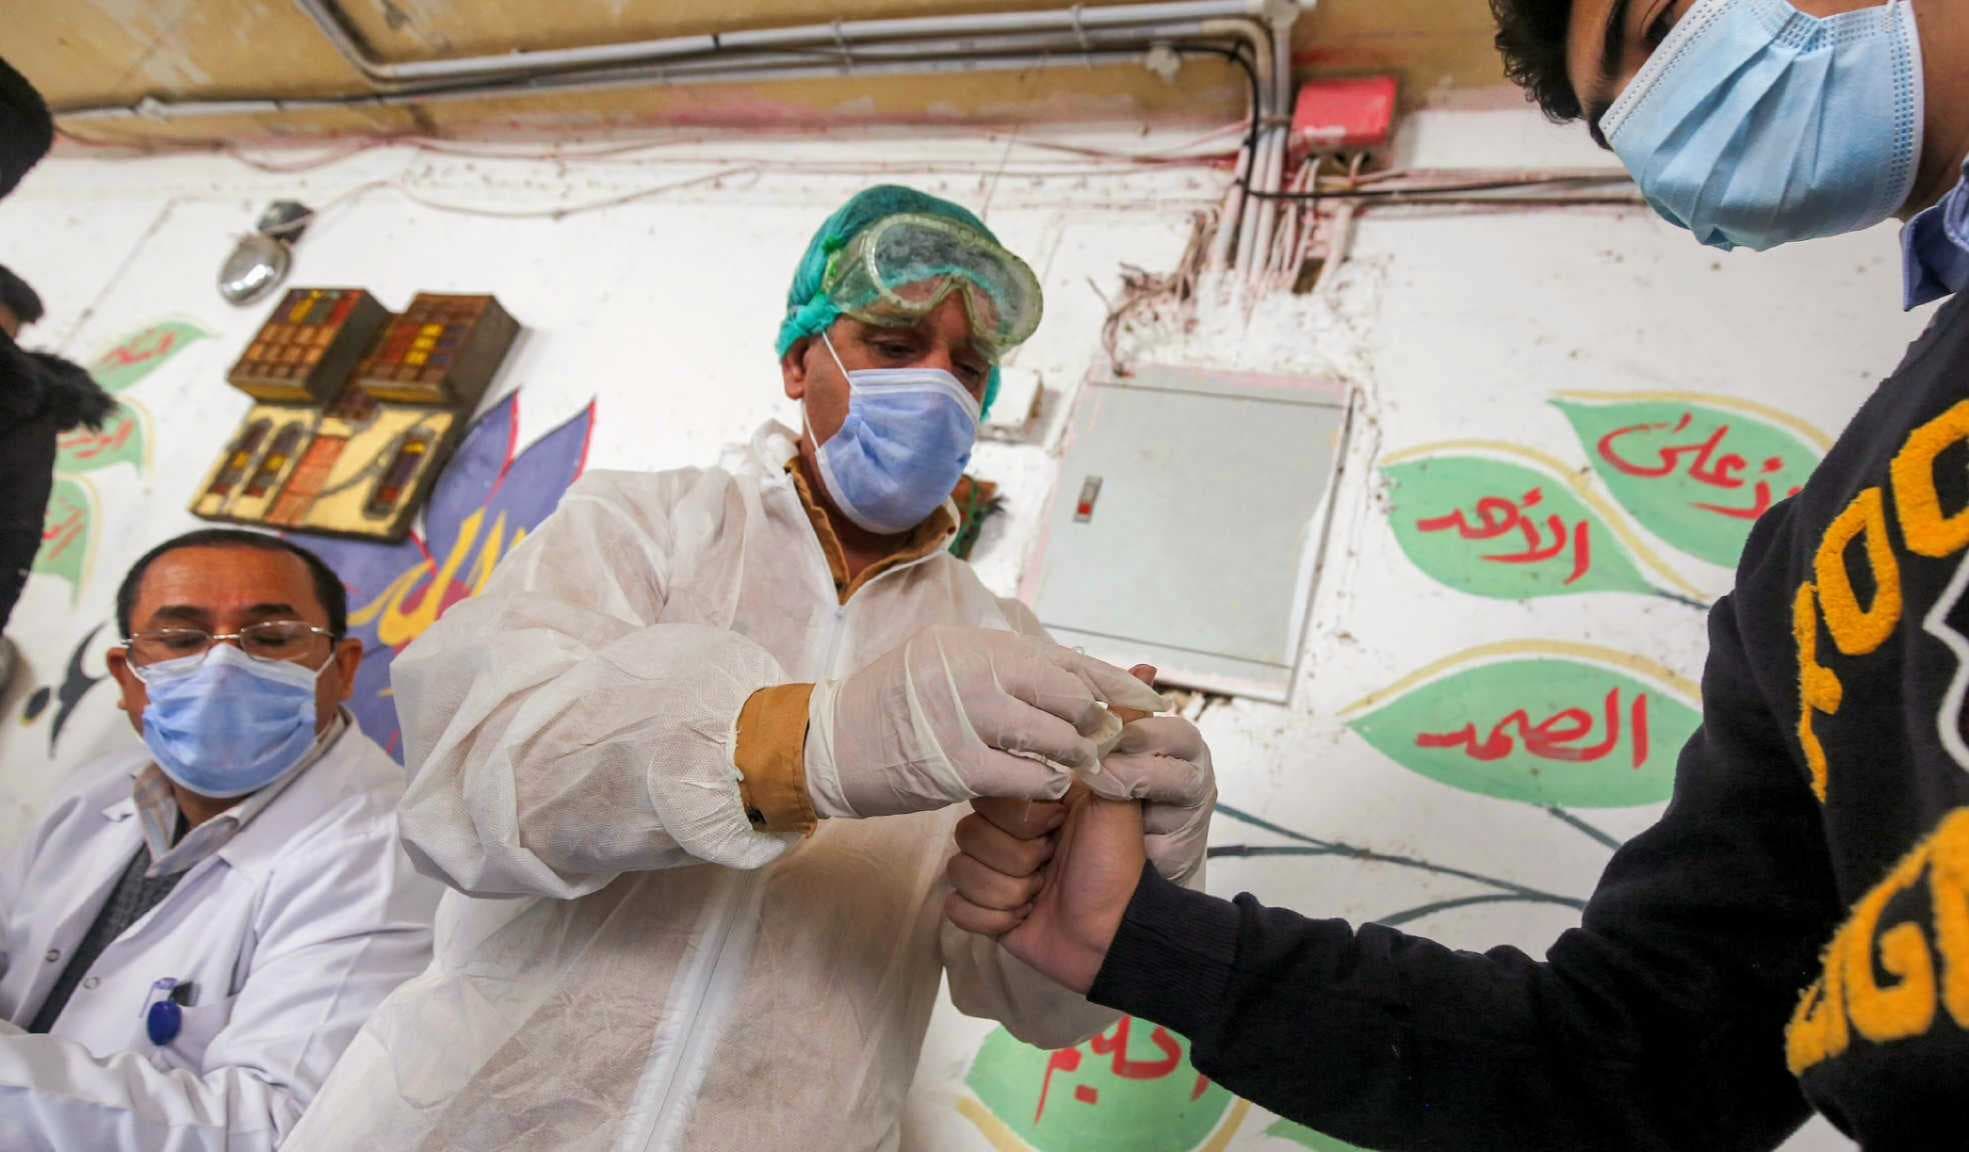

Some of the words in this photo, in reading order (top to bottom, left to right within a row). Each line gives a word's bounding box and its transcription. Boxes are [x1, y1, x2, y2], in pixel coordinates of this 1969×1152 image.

[1597, 411, 1806, 520] لأعلى
[346, 507, 527, 646] لله
[1414, 686, 1648, 770] الصمد
